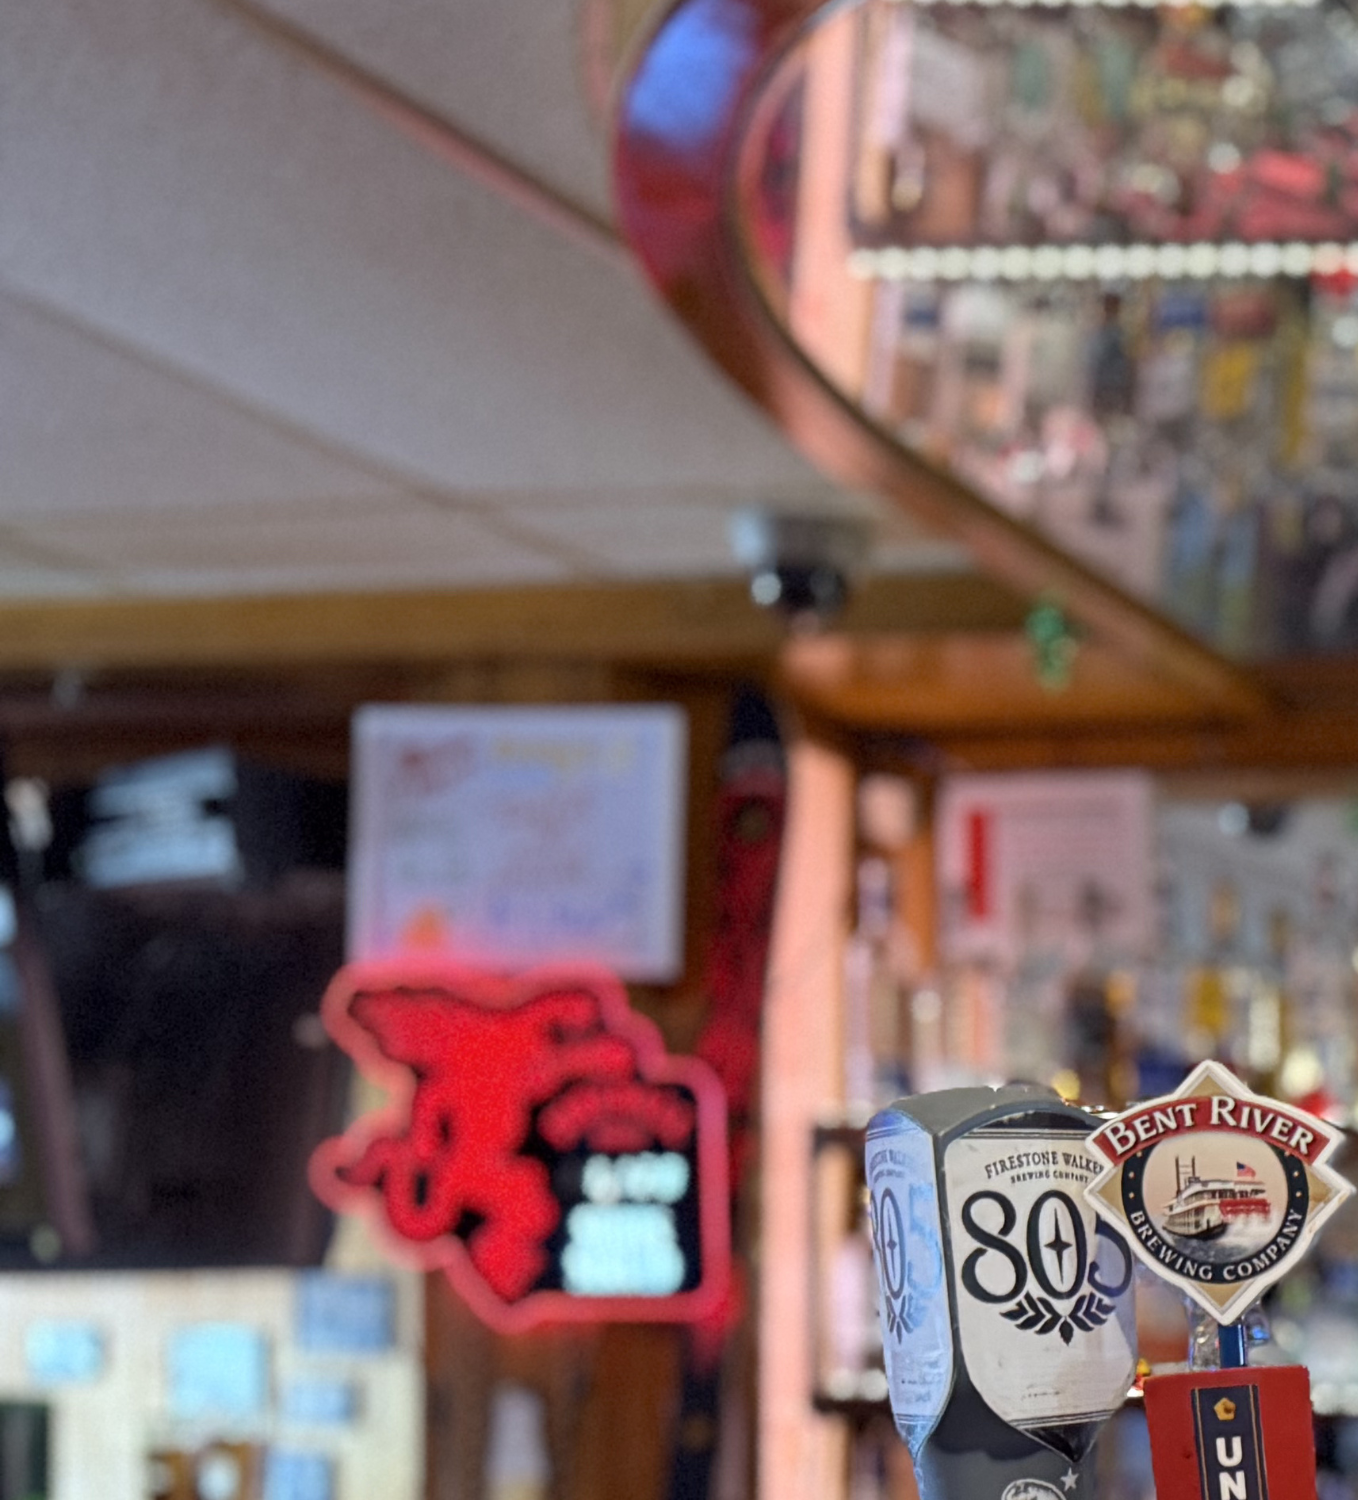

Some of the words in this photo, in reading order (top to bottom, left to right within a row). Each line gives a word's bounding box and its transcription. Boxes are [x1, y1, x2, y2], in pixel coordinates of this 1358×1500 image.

[1103, 1103, 1197, 1155] BENT
[1210, 1095, 1315, 1155] RIVER
[984, 1151, 1059, 1179] FIRESTONE
[1010, 1169, 1050, 1184] BREWING
[1053, 1170, 1089, 1184] COMPANY
[1130, 1210, 1214, 1281] BREWING
[1222, 1209, 1303, 1280] COMPANY
